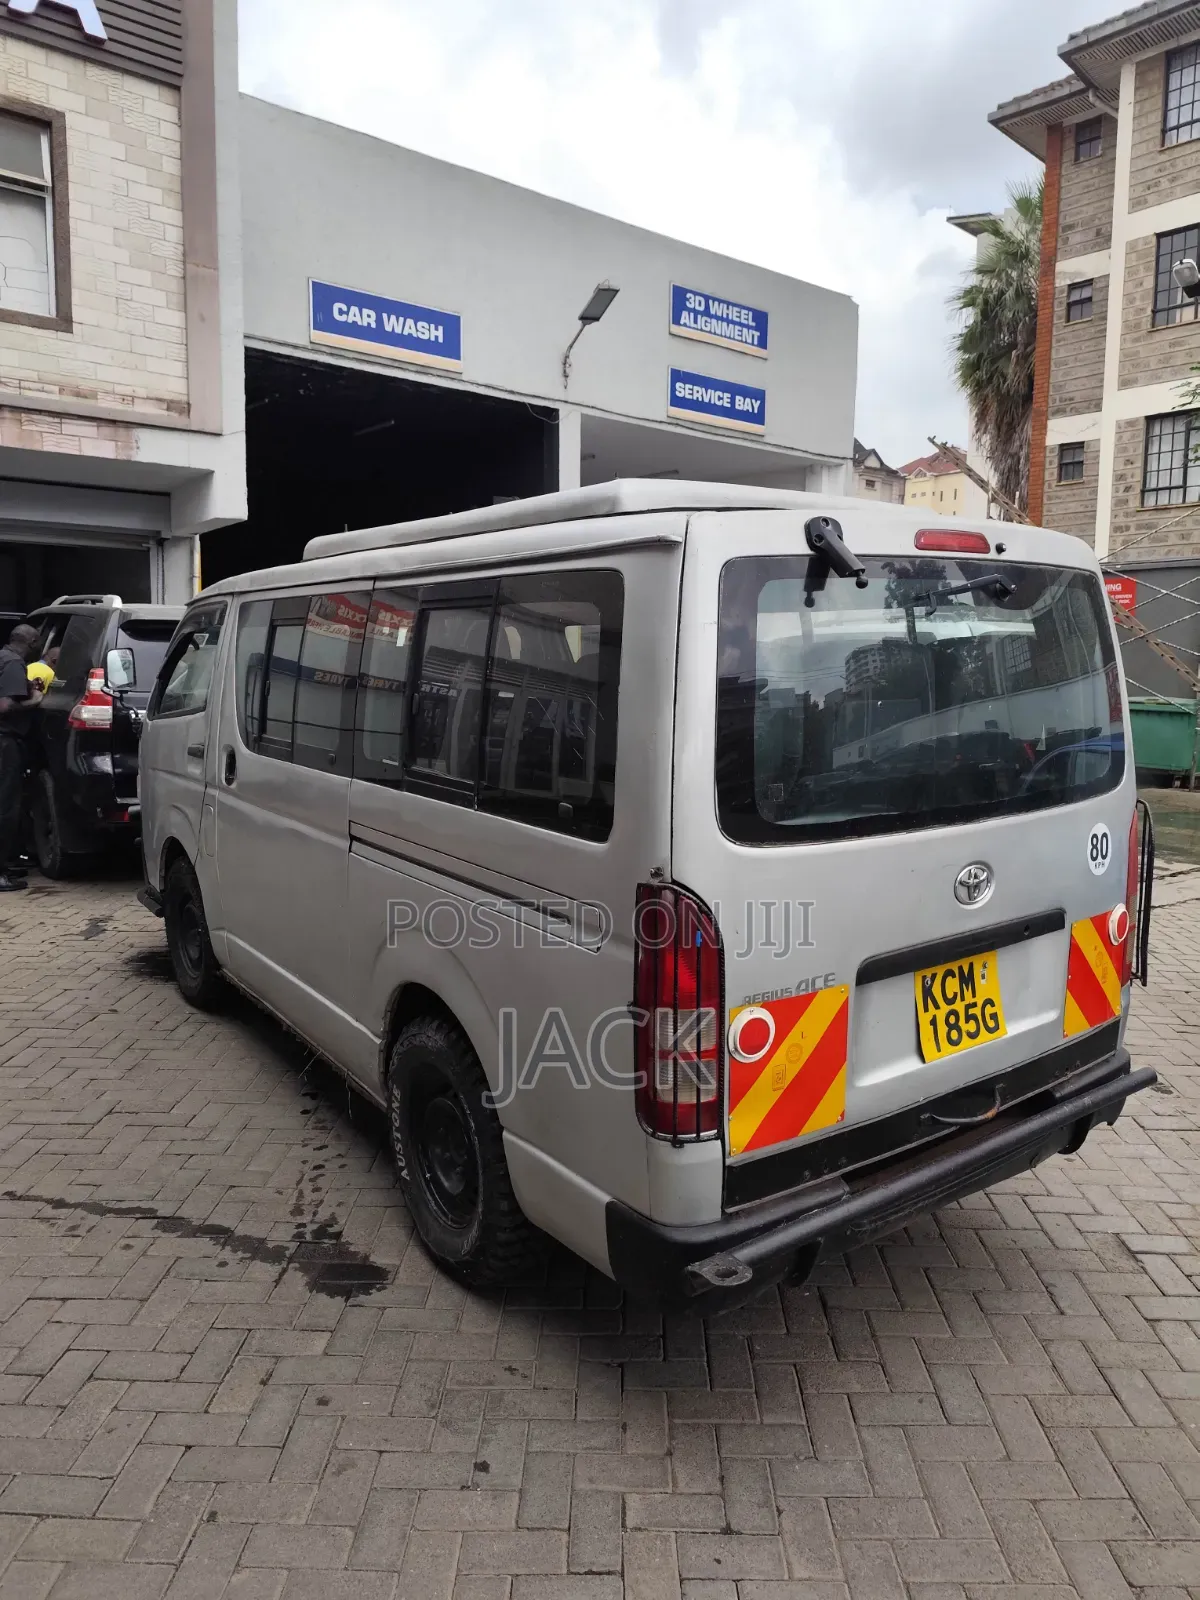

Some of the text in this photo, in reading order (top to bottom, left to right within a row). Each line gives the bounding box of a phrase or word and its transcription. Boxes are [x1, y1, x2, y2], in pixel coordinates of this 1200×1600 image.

[332, 302, 444, 343] CAR WASH
[685, 293, 756, 326] 3D WHEEL
[680, 310, 760, 345] ALIGNMENT
[675, 382, 761, 414] SERVICE BAY
[1090, 832, 1108, 861] 80
[743, 972, 836, 1006] REGIUS ACE
[921, 961, 977, 1013] KCM
[929, 997, 1001, 1053] 185G
[391, 1084, 411, 1181] AUSTONE
